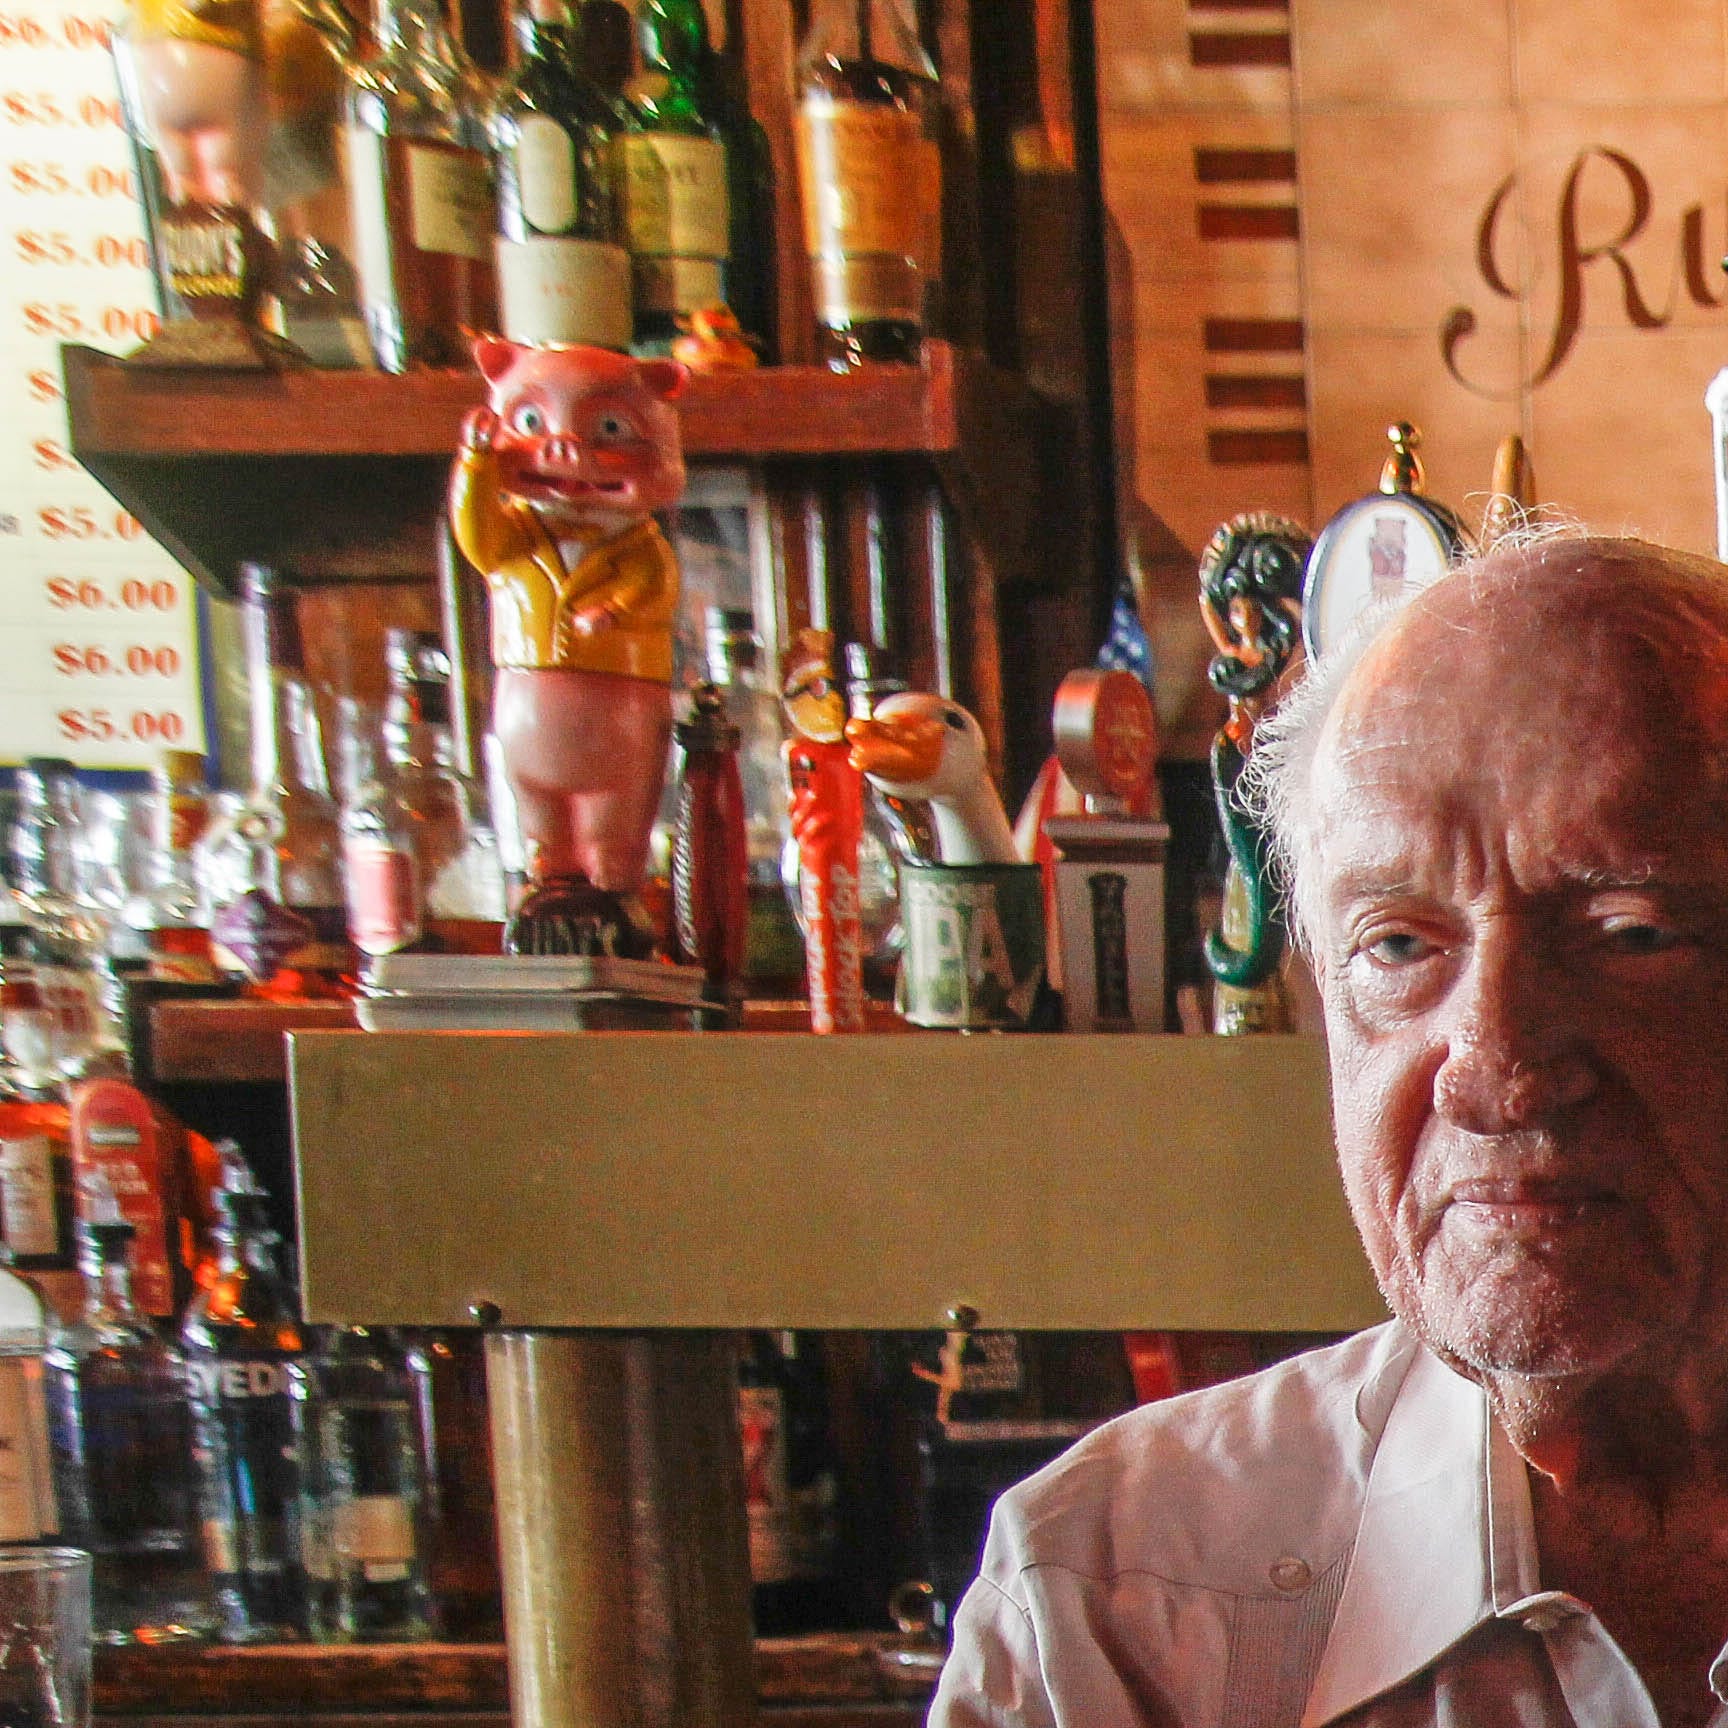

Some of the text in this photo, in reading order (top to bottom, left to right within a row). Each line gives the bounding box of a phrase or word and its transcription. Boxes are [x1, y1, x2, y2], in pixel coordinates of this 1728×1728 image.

[14, 229, 151, 271] $5.00
[22, 302, 163, 343] $5.00
[38, 506, 144, 541] $5.0
[44, 575, 178, 612] $6.00
[52, 642, 182, 678] $6.00
[57, 708, 184, 743] $5.00
